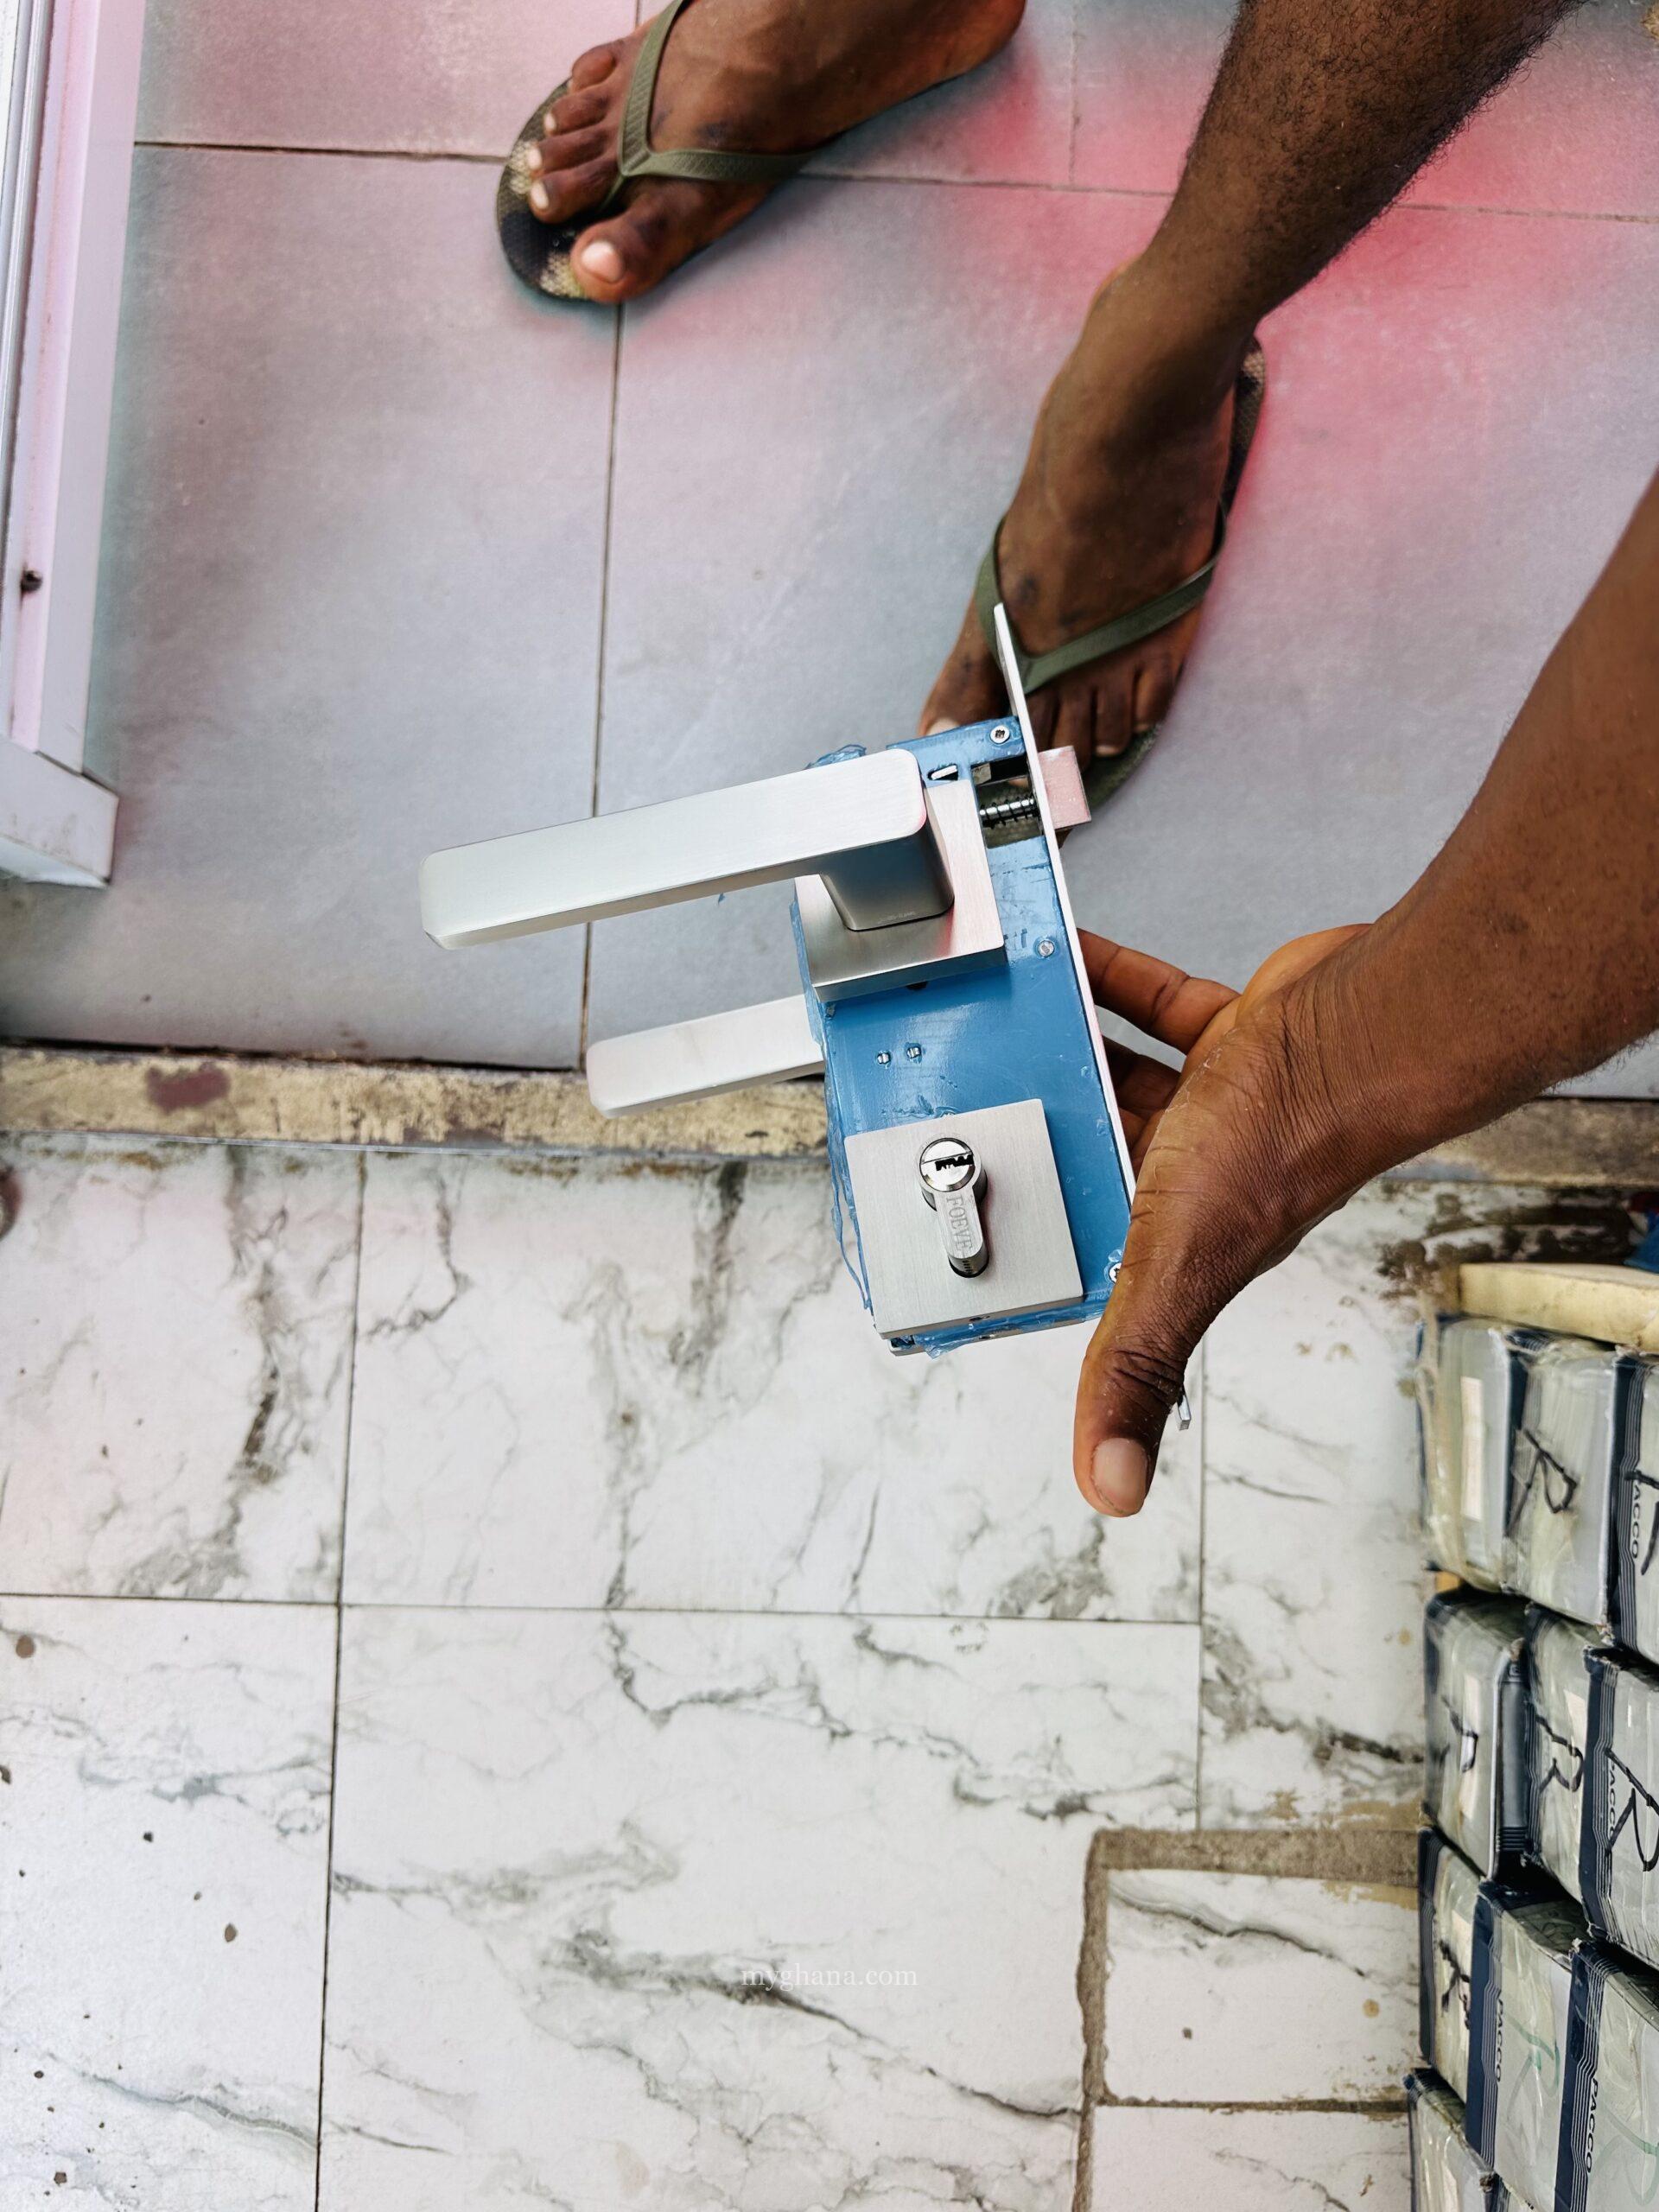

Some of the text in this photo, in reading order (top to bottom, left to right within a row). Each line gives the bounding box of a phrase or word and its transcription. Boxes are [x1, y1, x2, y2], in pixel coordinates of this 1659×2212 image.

[1631, 1474, 1642, 1560] ACCO
[1496, 1999, 1504, 2082] PACCO
[1586, 2078, 1599, 2173] PACCO
